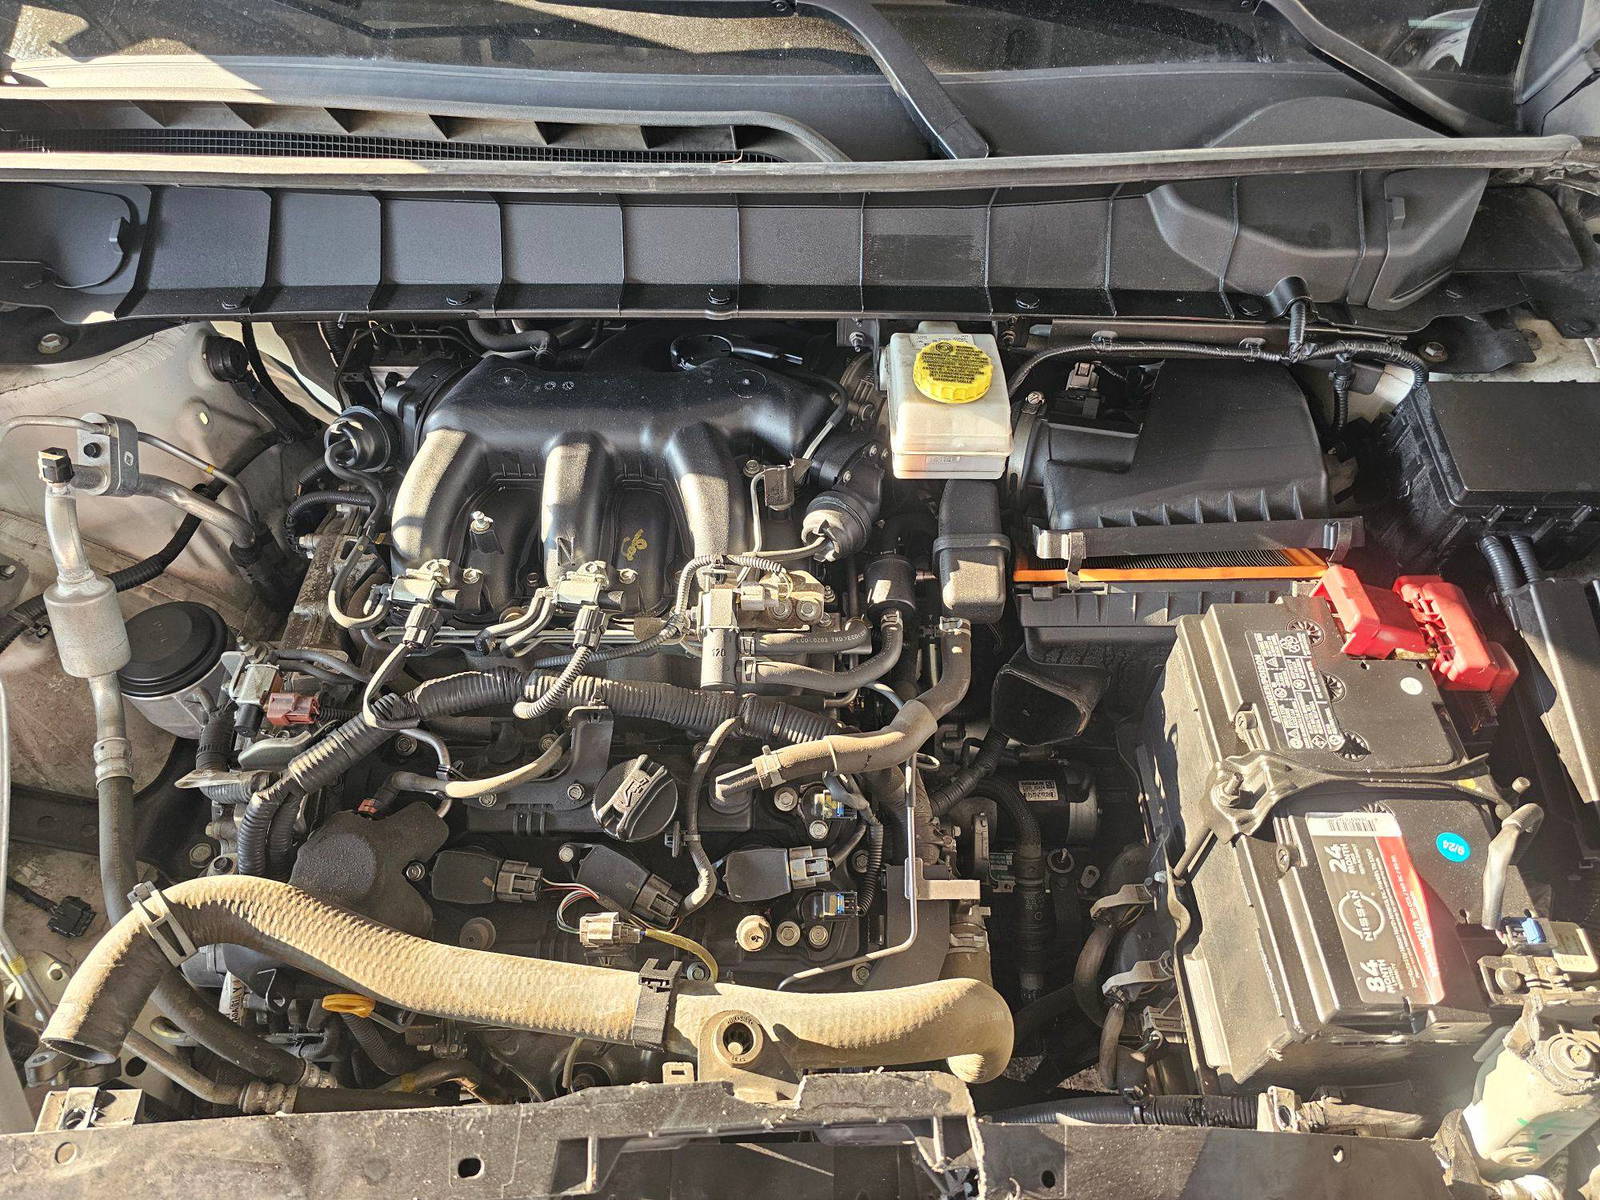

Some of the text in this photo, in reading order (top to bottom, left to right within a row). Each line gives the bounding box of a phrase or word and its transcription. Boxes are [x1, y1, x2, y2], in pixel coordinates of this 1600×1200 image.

[1324, 843, 1347, 873] 24
[1339, 843, 1356, 874] MONTH
[1349, 889, 1374, 941] NISSAN
[1360, 958, 1383, 993] 84
[1376, 958, 1396, 994] MONTH
